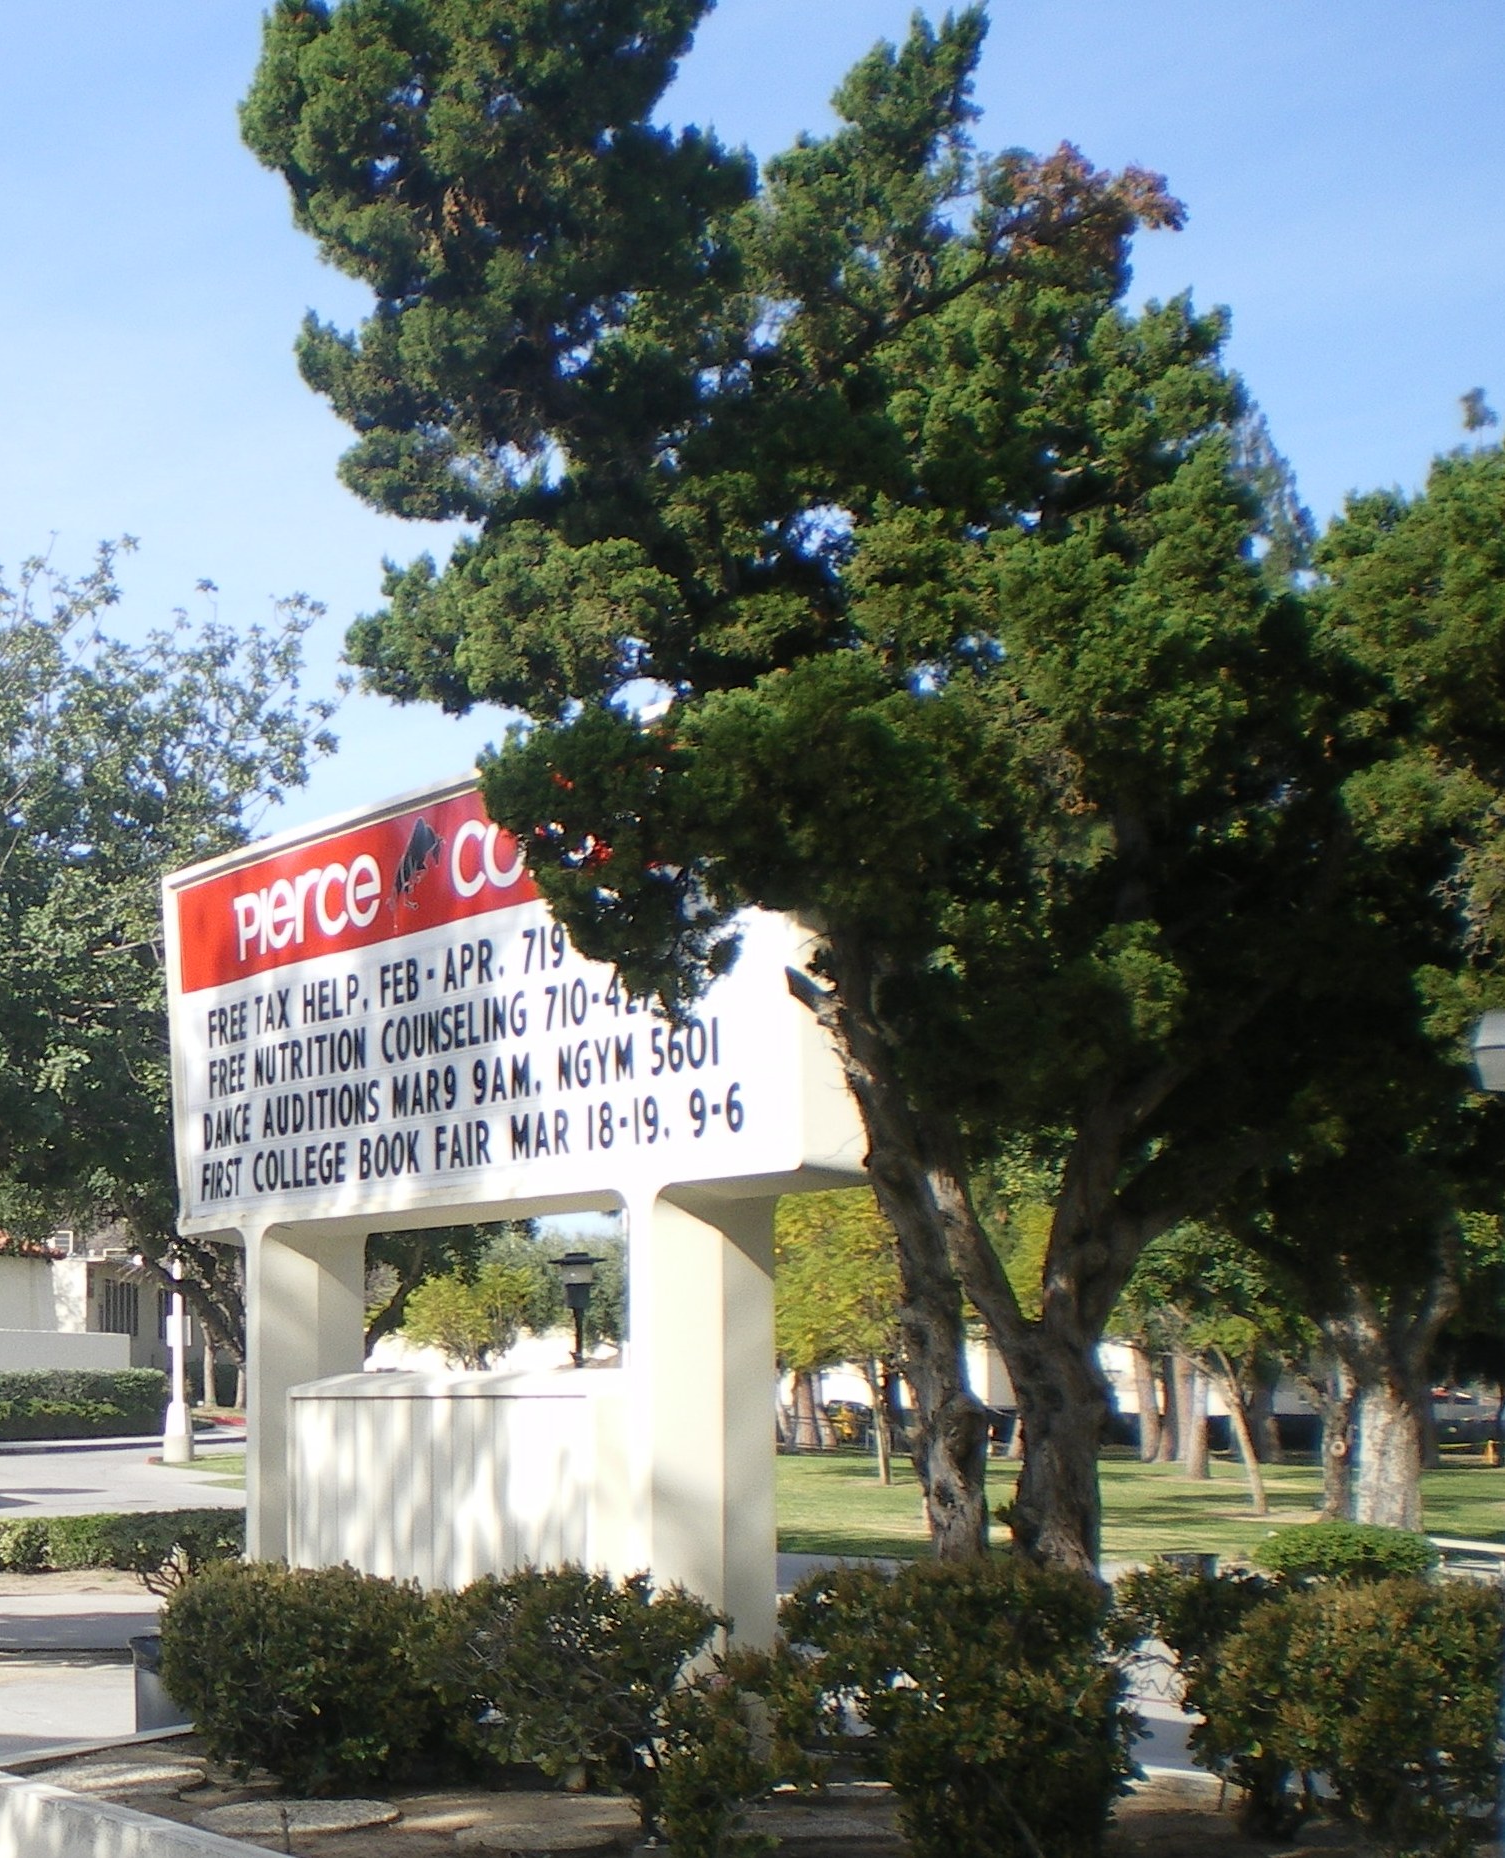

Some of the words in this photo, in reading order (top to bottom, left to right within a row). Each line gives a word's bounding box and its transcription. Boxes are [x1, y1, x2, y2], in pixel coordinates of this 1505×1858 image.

[208, 1001, 248, 1049] FREE
[255, 988, 290, 1035] TAX
[209, 1052, 246, 1099] FREE
[254, 1026, 367, 1088] NUTRITION
[381, 990, 528, 1064] COUNSELING
[203, 1102, 251, 1151] DANCE
[262, 1079, 381, 1139] AUDITIONS
[558, 1032, 635, 1091] NGYM
[651, 1016, 720, 1077] 5601
[201, 1156, 243, 1202] FIRST
[252, 1140, 347, 1193] COLLEGE
[359, 1129, 421, 1180] BOOK
[434, 1119, 492, 1170] FAIR
[511, 1108, 570, 1161] MAR
[689, 1081, 744, 1139] 9-6
